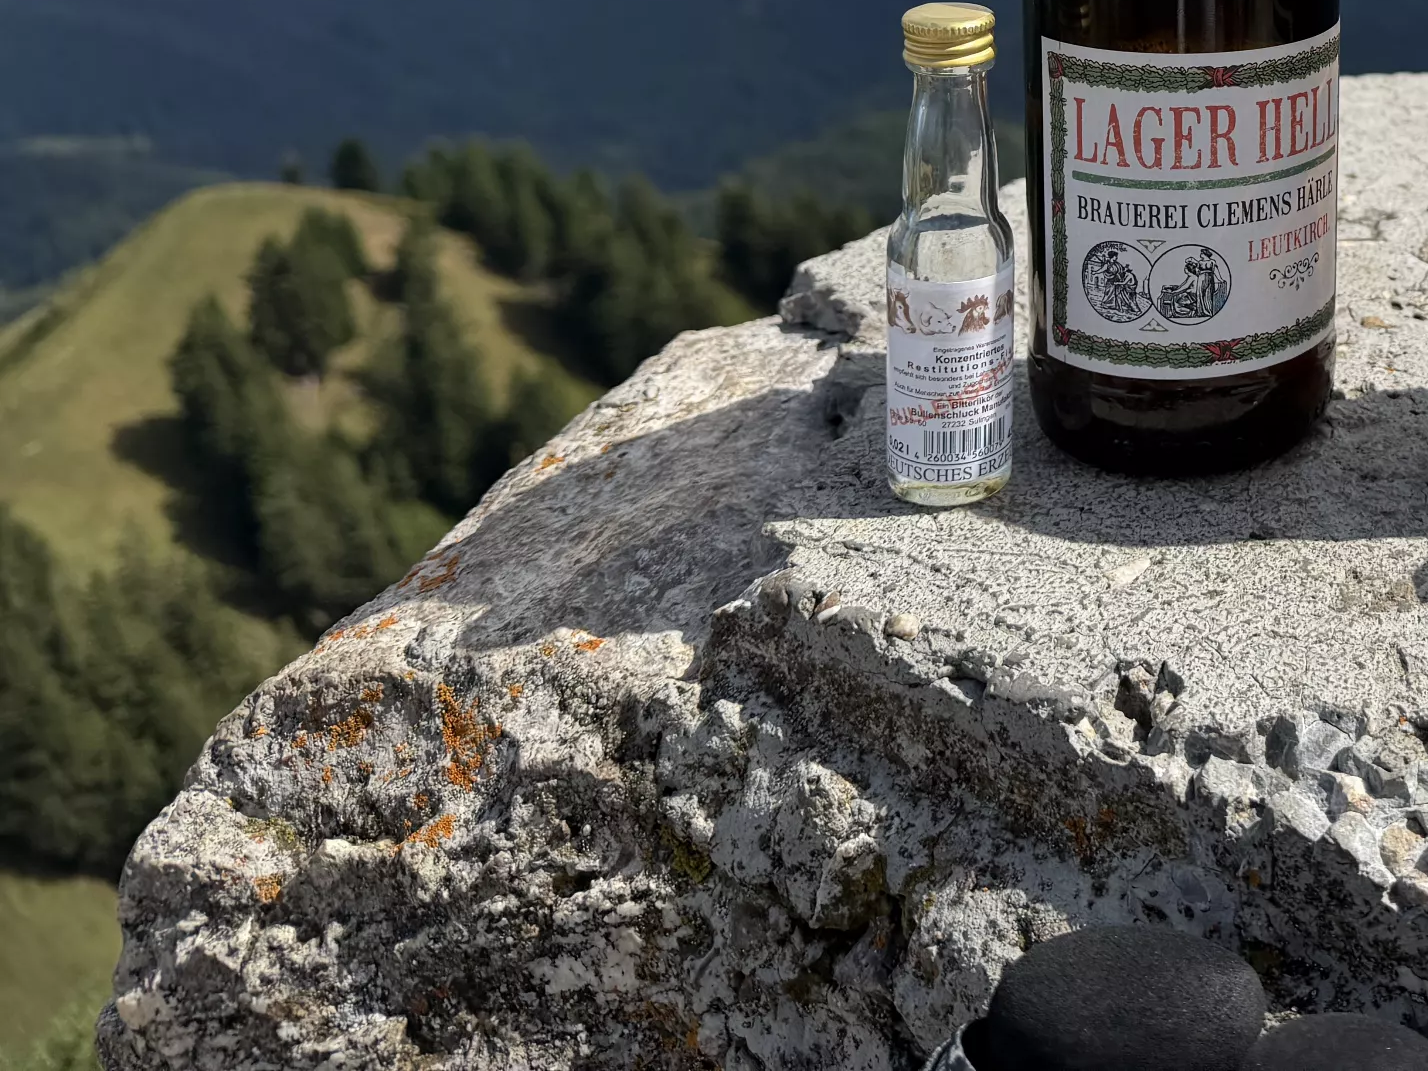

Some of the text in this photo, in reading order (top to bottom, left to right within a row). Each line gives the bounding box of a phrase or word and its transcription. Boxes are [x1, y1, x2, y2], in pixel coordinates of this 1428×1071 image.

[1073, 78, 1336, 170] LAGER HELL
[1077, 169, 1333, 229] BRAUEREI CLEMENS HÄRLE
[935, 344, 1005, 364] Konzentriertes
[928, 374, 963, 382] besonders
[937, 402, 950, 410] Ein
[951, 394, 994, 409] Bitterlikör
[911, 407, 979, 420] Bullenschluck
[942, 419, 966, 429] 27232
[914, 451, 920, 460] 4
[927, 453, 966, 462] 260034
